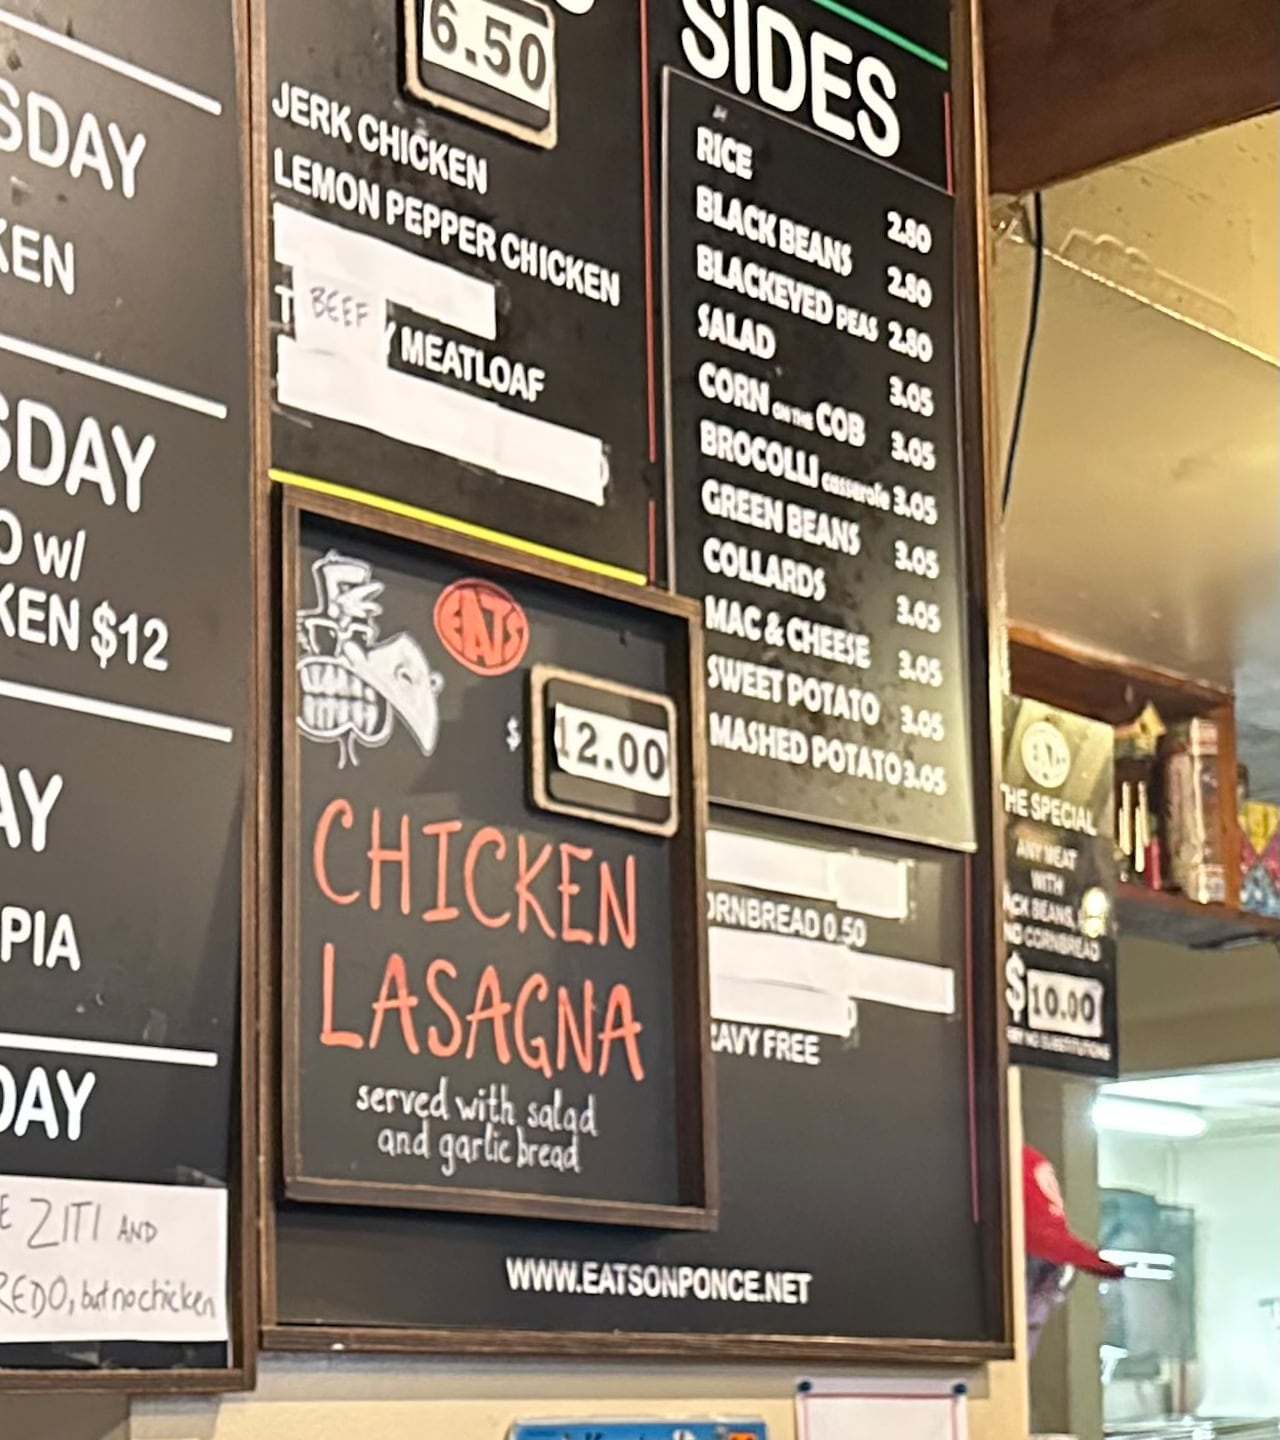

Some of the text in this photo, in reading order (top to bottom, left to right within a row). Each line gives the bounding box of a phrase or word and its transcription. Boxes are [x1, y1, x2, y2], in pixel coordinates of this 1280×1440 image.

[429, 0, 547, 92] 6.50
[681, 0, 900, 157] SIDES
[272, 81, 488, 194] JERK CHICKEN
[274, 147, 620, 306] LEMON PEPPER CHICKEN
[697, 126, 932, 253] RICE 2.80
[696, 185, 933, 308] BLACK BEANS 2.80
[310, 286, 369, 328] BEEF
[696, 244, 933, 362] BLACKEYED PEAS 2.80
[400, 326, 545, 402] MEATLOAF
[698, 303, 934, 417] SALAD 3.05
[698, 362, 770, 415] CORN
[816, 402, 866, 447] COB
[891, 431, 936, 471] 3.05
[700, 419, 937, 525] BROCOLLI casserole 3.05
[33, 530, 86, 581] w/
[701, 479, 939, 579] GREEN BEANS 3.05
[440, 582, 526, 668] EATS
[703, 537, 941, 633] COLLARDS 3.05
[92, 601, 169, 672] $12
[705, 595, 943, 688] MAC & CHEESE 3.05
[707, 654, 944, 741] SWEET POTATO 3.05
[507, 714, 666, 781] $ 12.00
[709, 712, 947, 796] MASHED POTATO 3.05
[1031, 792, 1098, 837] SPECIAL
[314, 799, 636, 949] CHICKEN
[320, 942, 645, 1081] LASAGNA
[763, 1029, 820, 1066] FREE
[1032, 984, 1095, 1022] 10.00
[356, 1076, 598, 1137] served with salad
[378, 1123, 582, 1177] and garlic bread
[27, 1197, 101, 1249] ZITI
[117, 1214, 158, 1243] AND
[506, 1256, 813, 1304] WWW.EATSONPONCE.NET
